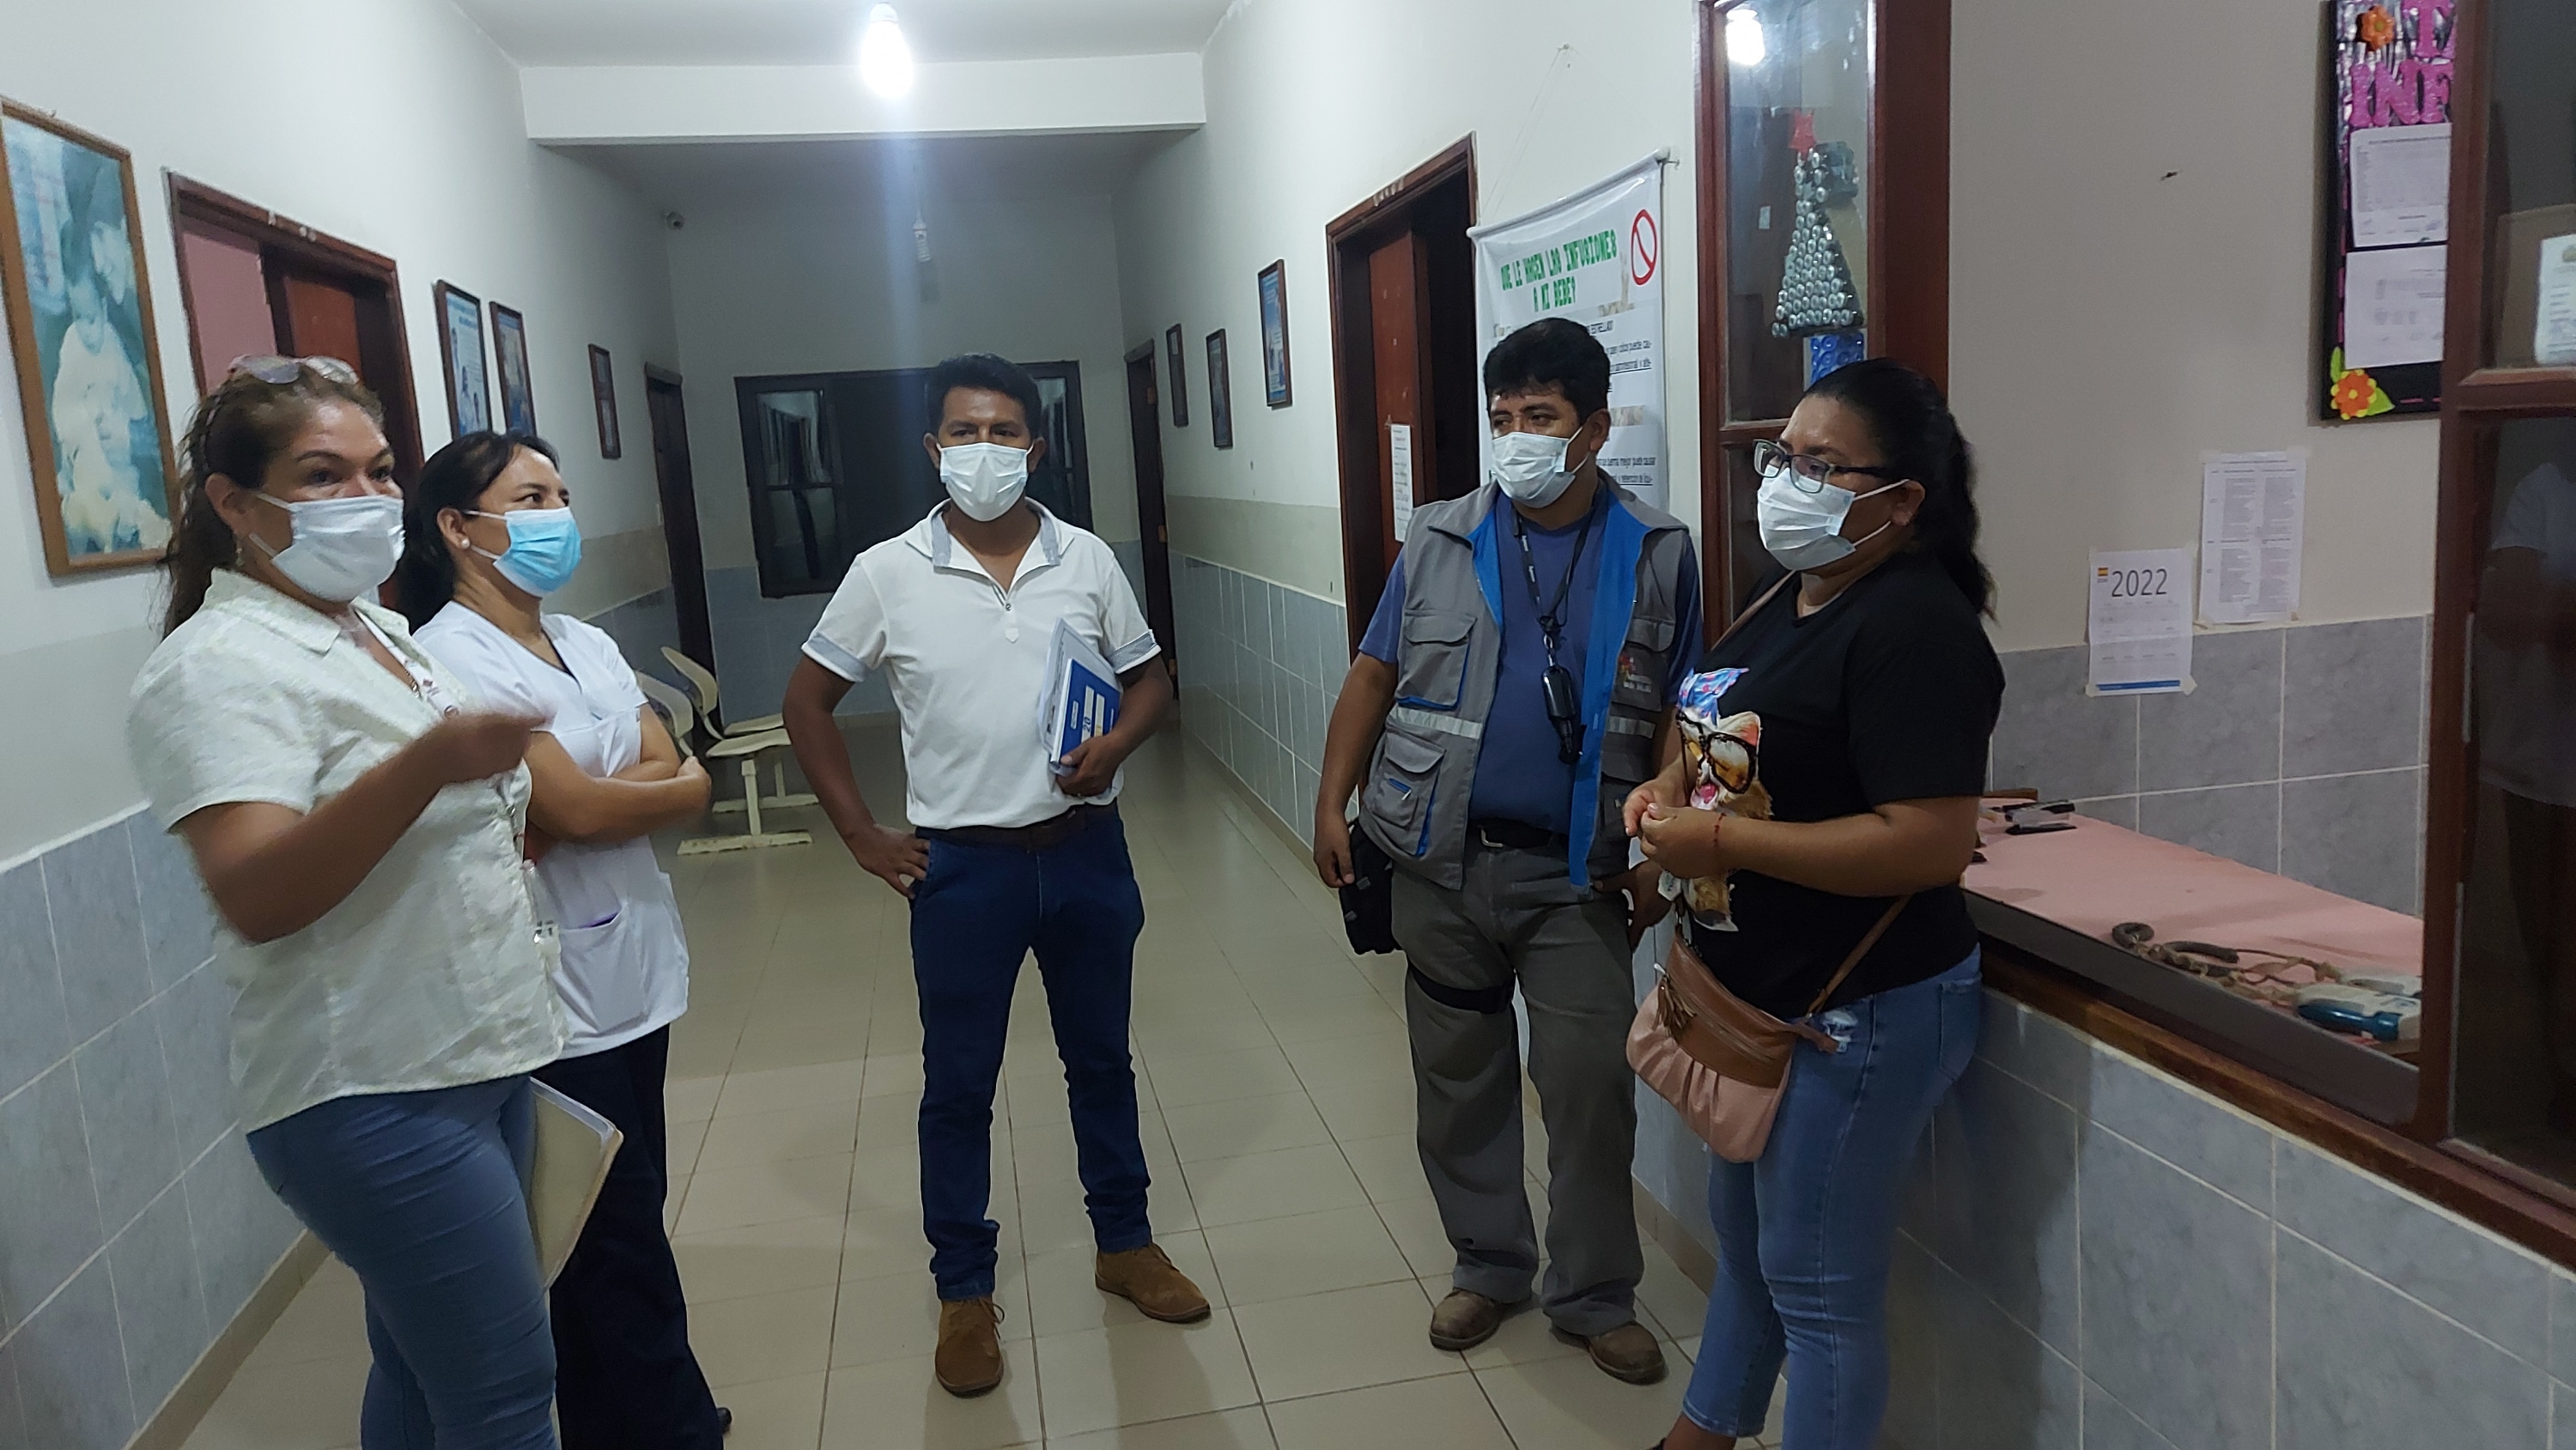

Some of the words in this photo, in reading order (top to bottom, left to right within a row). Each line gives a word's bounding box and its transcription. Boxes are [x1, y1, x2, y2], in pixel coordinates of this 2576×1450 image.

[1513, 260, 1522, 288] LE
[1523, 252, 1546, 284] HACEN
[1546, 247, 1562, 276] LAS
[1563, 229, 1617, 271] INFUSIONES
[1534, 287, 1539, 312] A
[1540, 283, 1550, 311] MI
[2111, 567, 2167, 598] 2022
